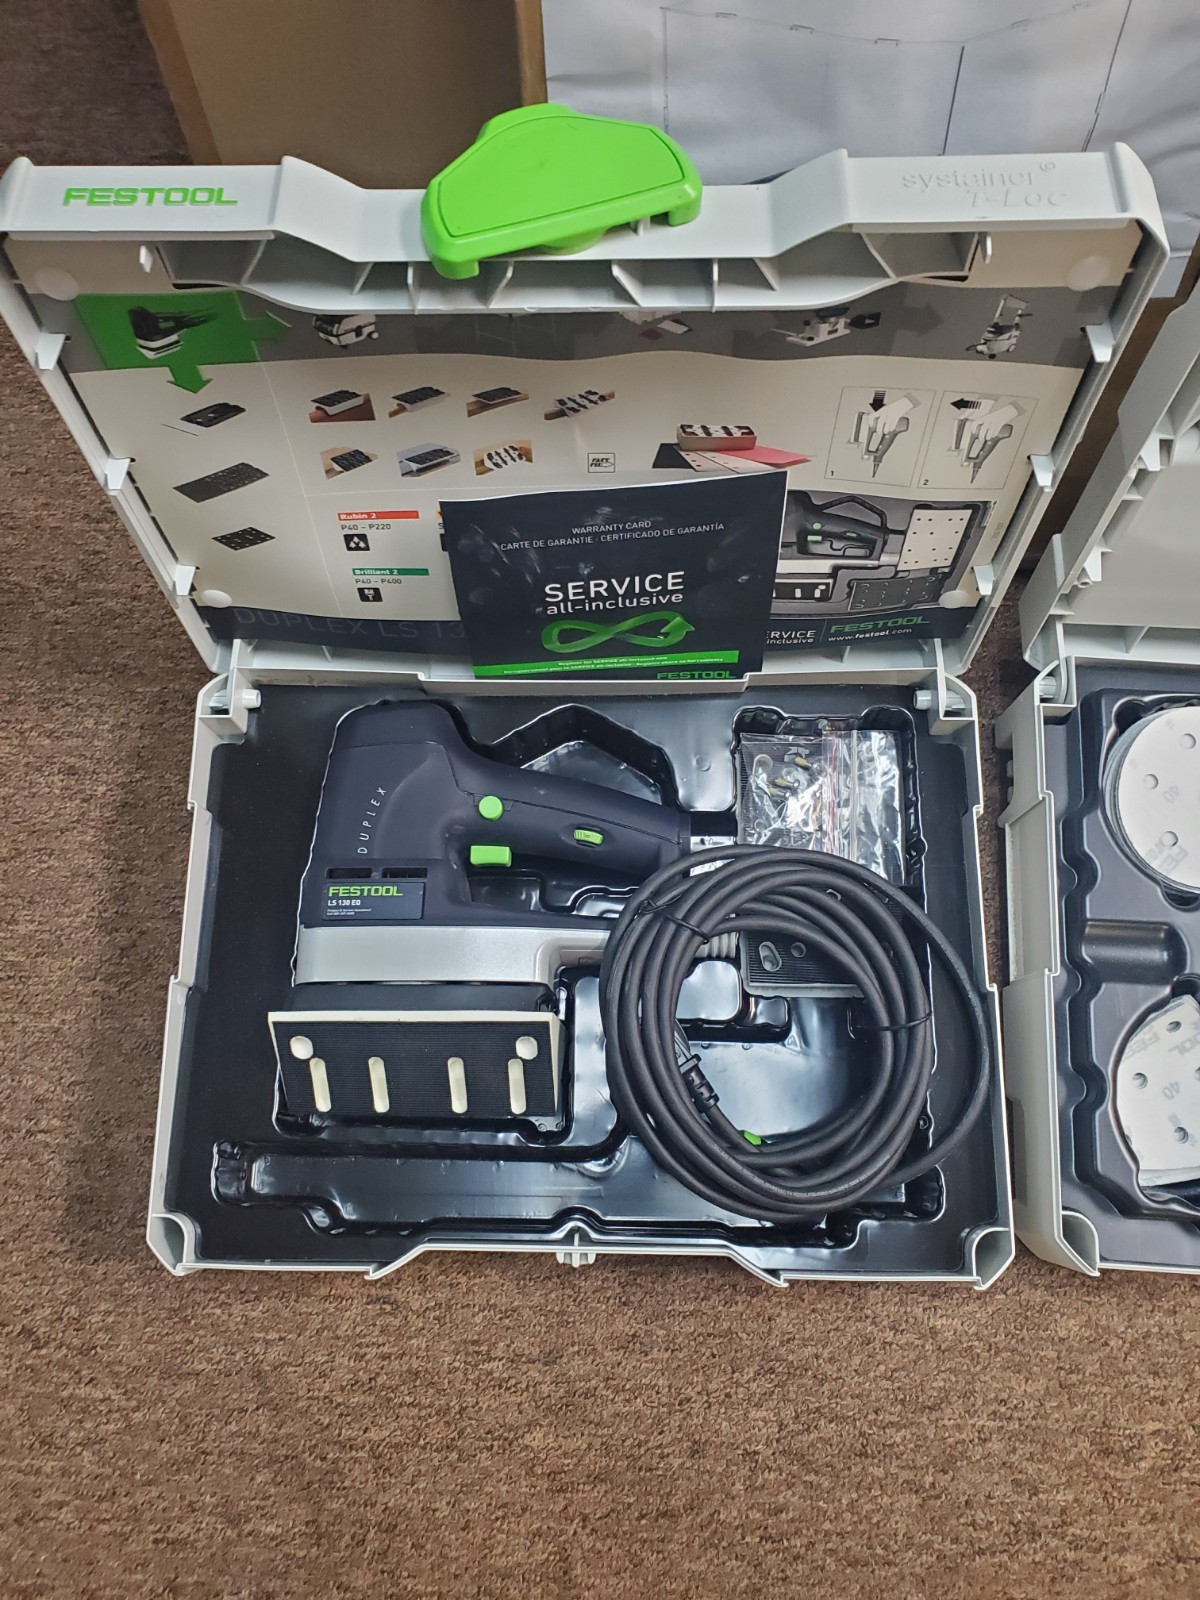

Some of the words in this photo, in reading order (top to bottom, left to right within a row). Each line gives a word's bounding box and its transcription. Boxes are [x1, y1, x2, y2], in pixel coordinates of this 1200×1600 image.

[63, 187, 238, 206] FESTOOL
[500, 540, 531, 551] CARTE
[532, 539, 545, 548] DE
[547, 536, 594, 547] GARANTIE
[600, 530, 661, 542] CERTIFICADO
[662, 528, 676, 537] DE
[677, 522, 725, 535] GARANTÍA
[571, 523, 625, 535] WARRANTY
[625, 520, 652, 529] CARD
[544, 571, 685, 603] SERVICE
[546, 592, 684, 615] all-inclusive
[232, 608, 369, 635] DUPLEX
[377, 621, 418, 639] LS
[830, 616, 930, 633] FESTOOL
[828, 627, 912, 642] www.festool.com
[656, 671, 737, 680] FESTOOL
[357, 787, 387, 854] DUPLEX
[328, 885, 404, 897] FESTOOL
[1162, 1081, 1180, 1100] 40
